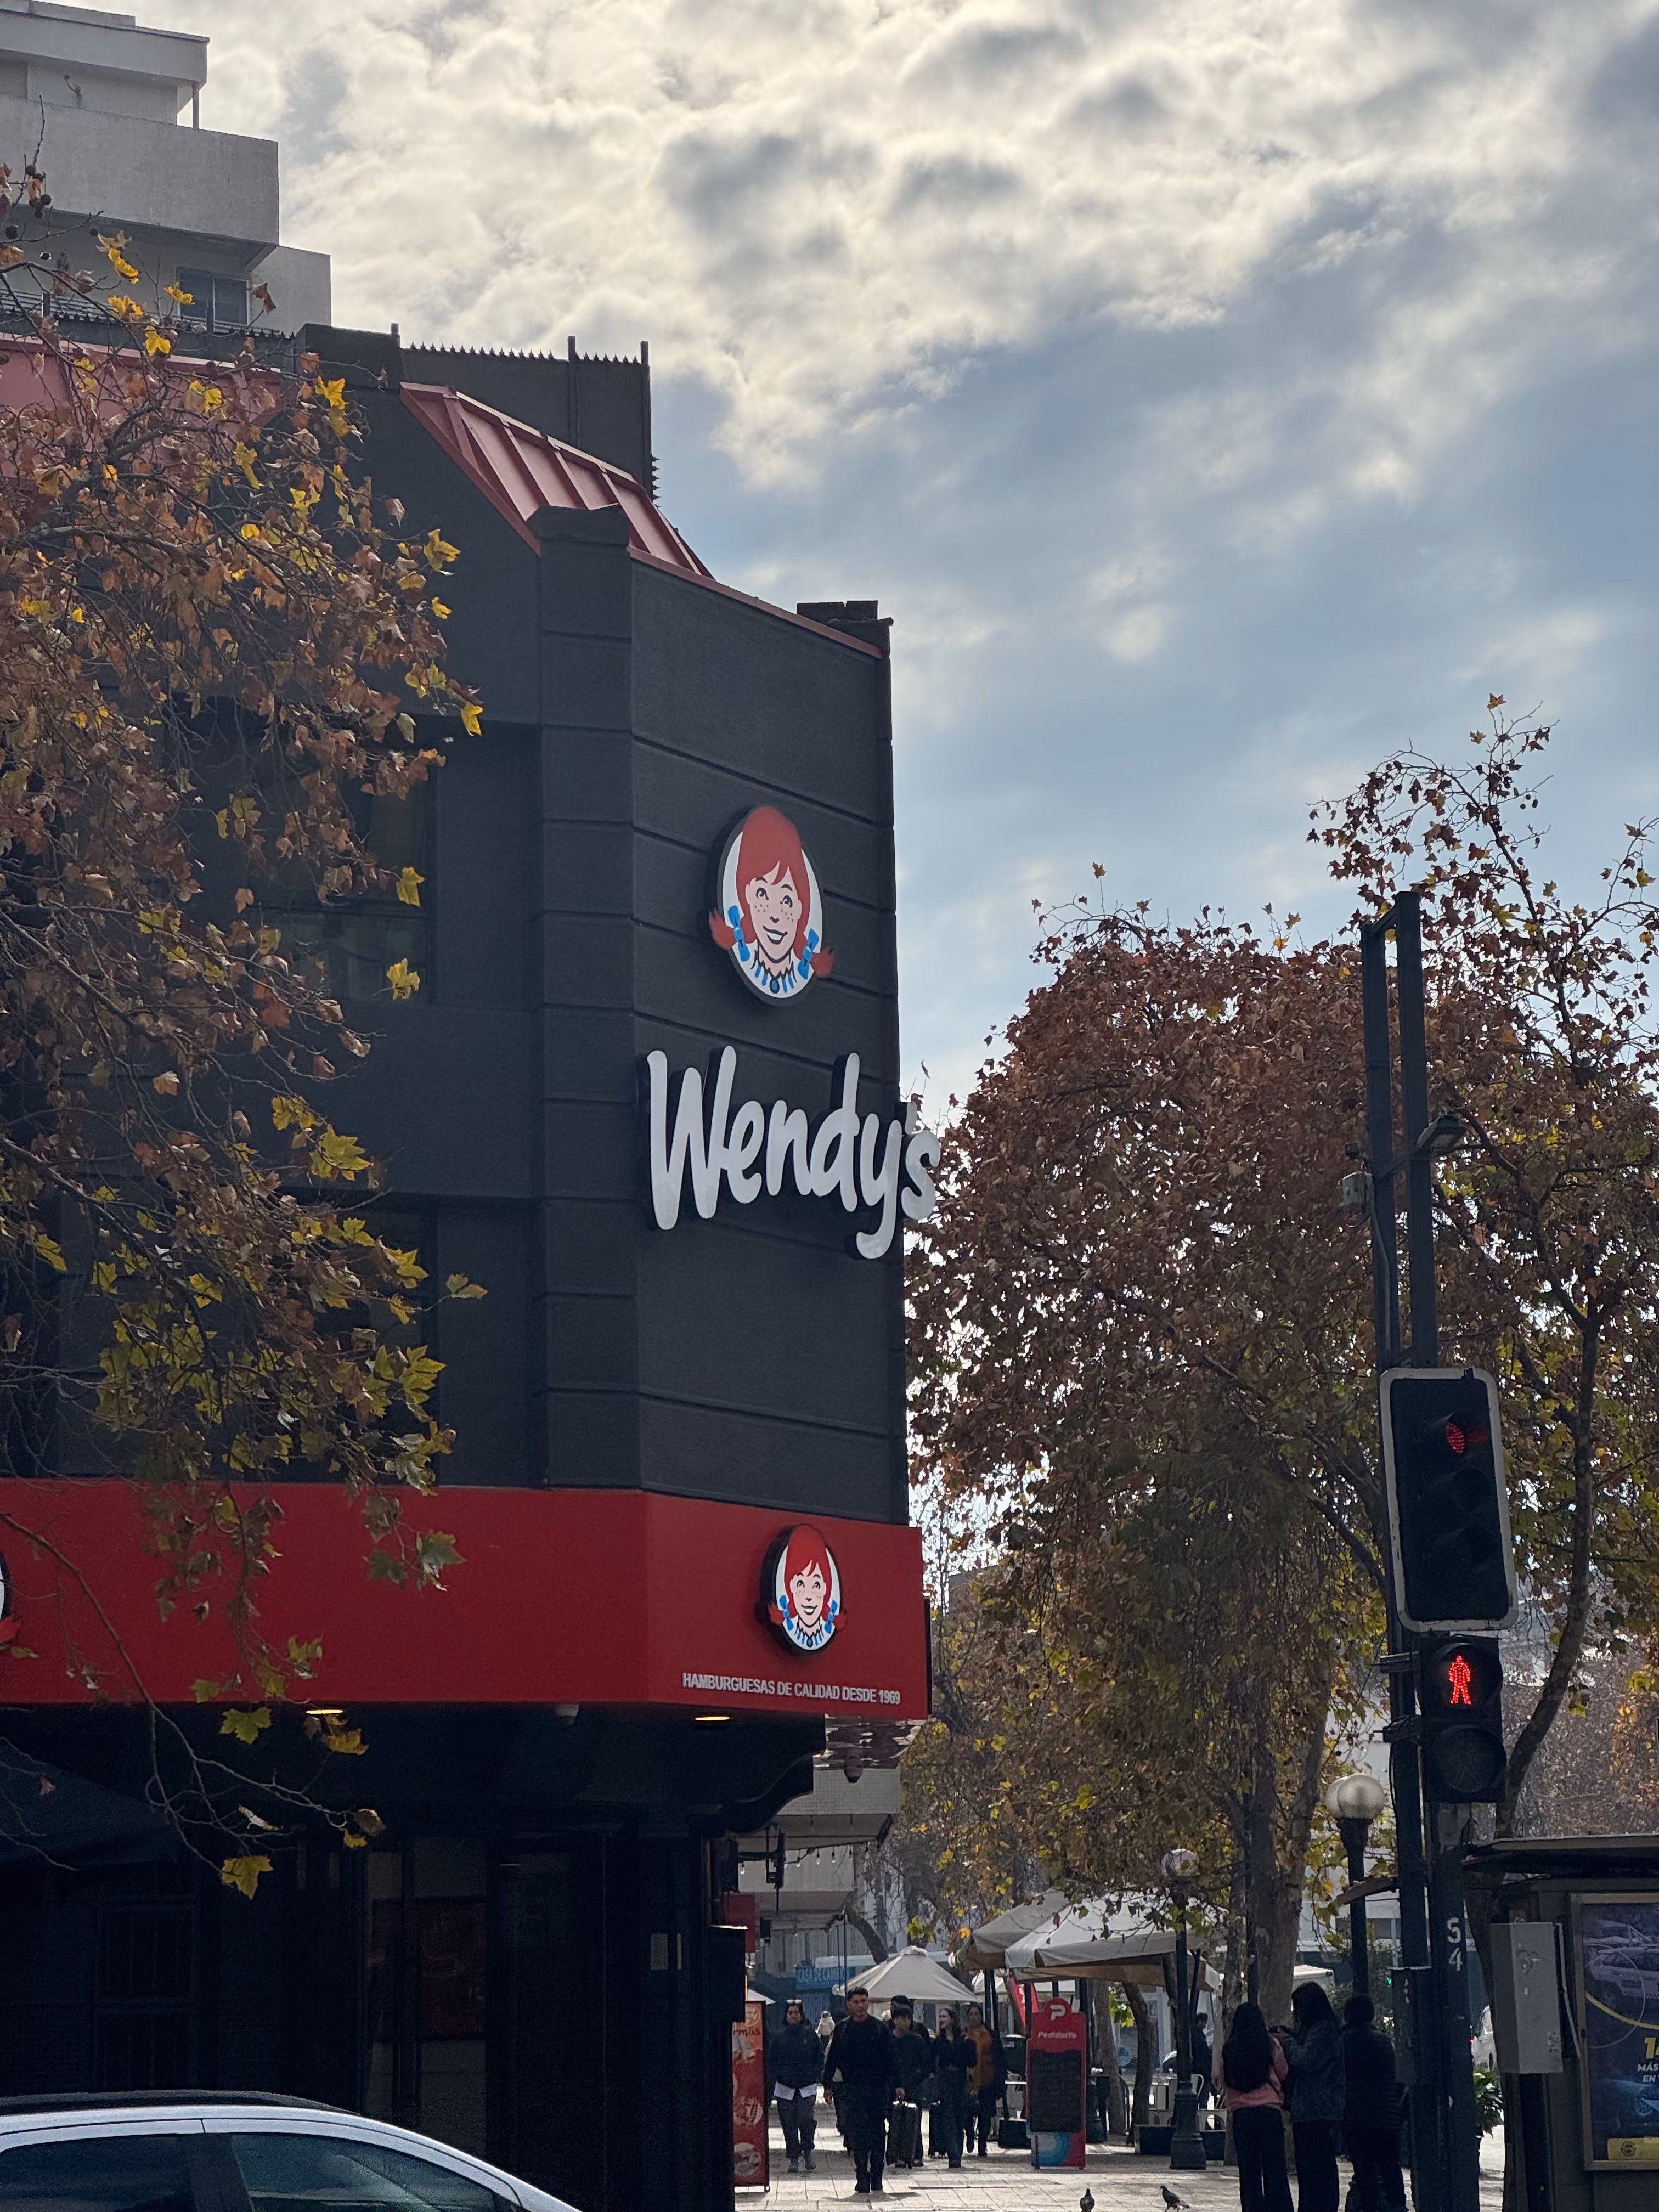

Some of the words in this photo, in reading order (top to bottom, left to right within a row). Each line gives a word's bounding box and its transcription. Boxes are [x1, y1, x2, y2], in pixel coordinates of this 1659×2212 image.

[647, 1046, 940, 1259] Wendy's
[682, 1673, 775, 1695] HAMBURGUESAS
[777, 1681, 793, 1696] DE
[794, 1683, 840, 1700] CALIDAD
[842, 1686, 877, 1702] DESDE
[879, 1690, 900, 1705] 1969
[798, 1968, 814, 1983] CASA
[814, 1967, 822, 1982] DE
[1038, 2031, 1077, 2039] PedidosYa
[1637, 2062, 1659, 2072] MÁS
[1643, 2075, 1656, 2083] EN
